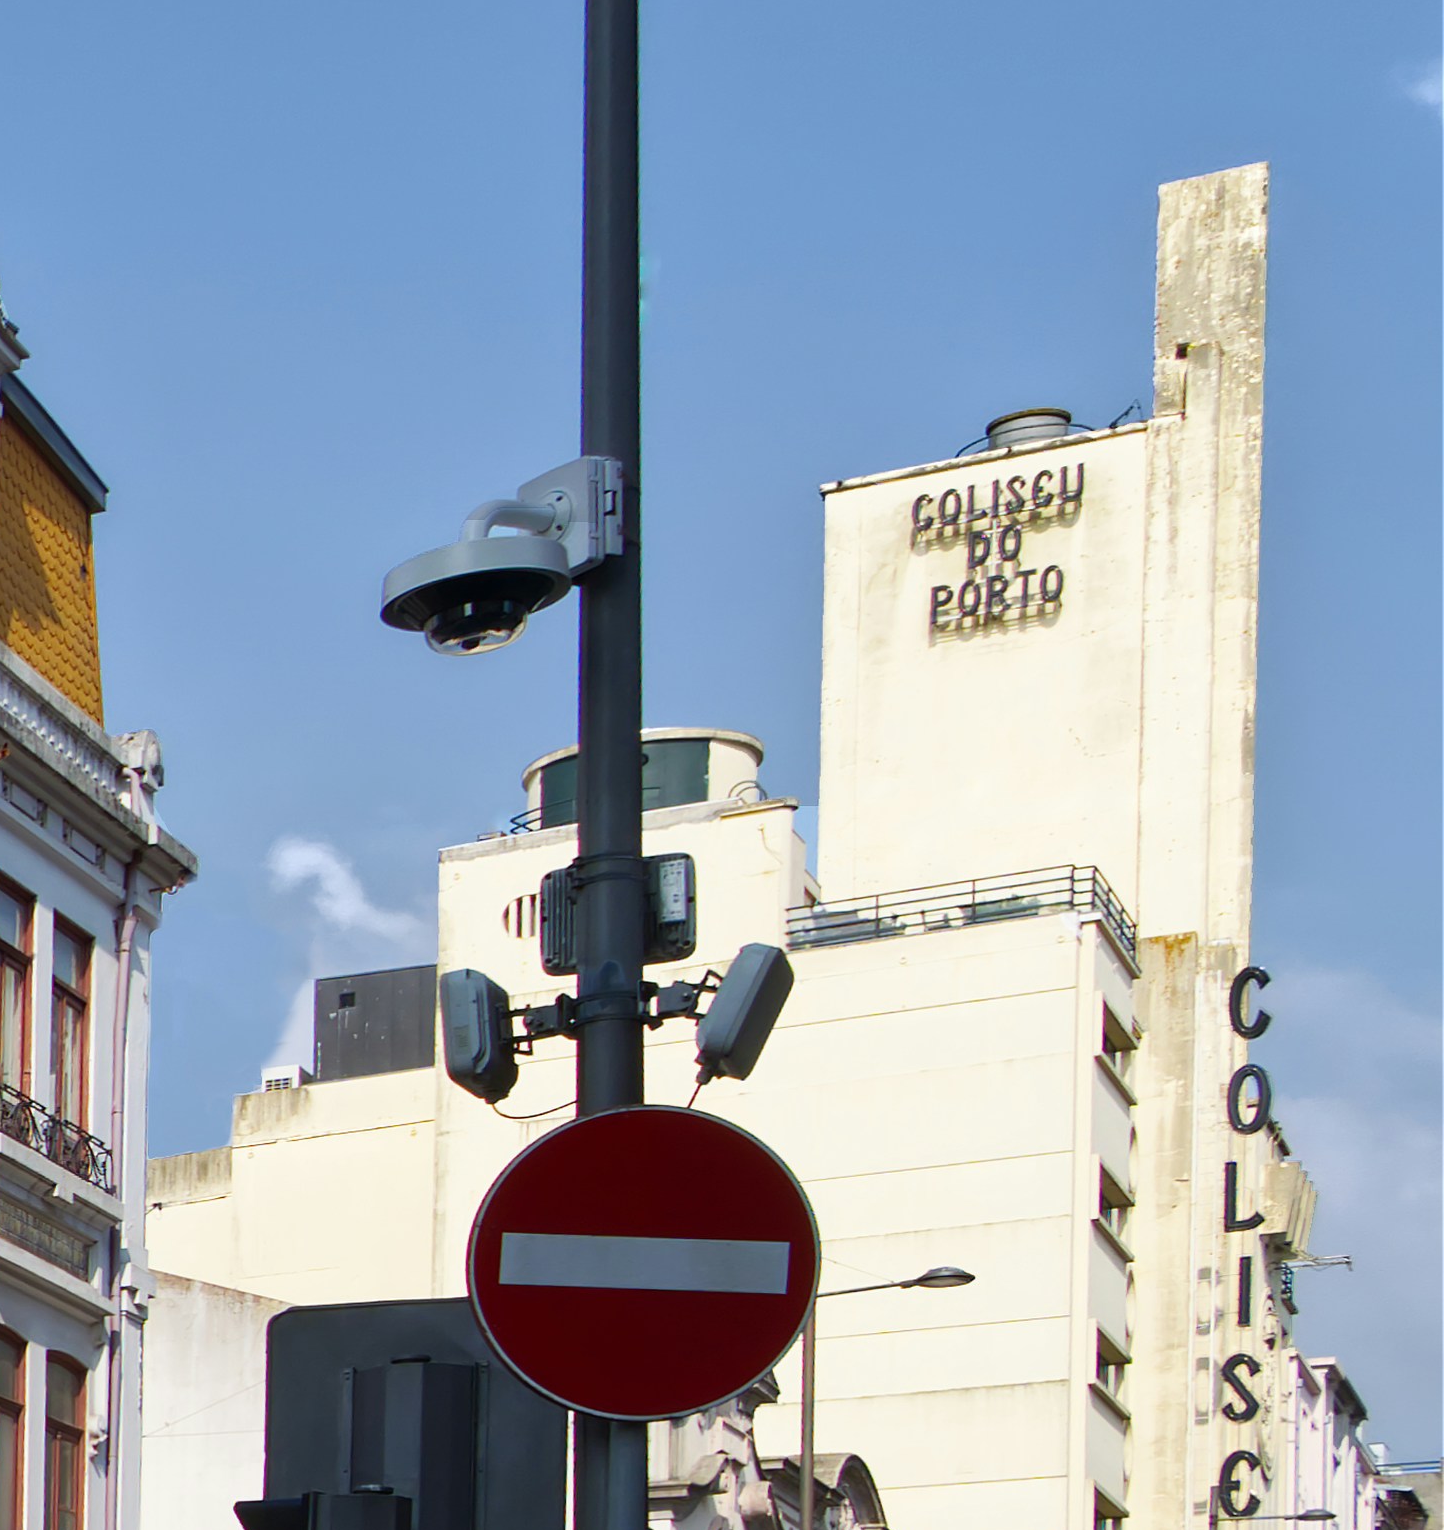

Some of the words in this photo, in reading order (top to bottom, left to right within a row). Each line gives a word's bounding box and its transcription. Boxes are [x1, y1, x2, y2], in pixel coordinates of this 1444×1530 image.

[911, 463, 1085, 531] COLISEU
[967, 524, 1023, 571] DO
[930, 565, 1064, 625] PORTO
